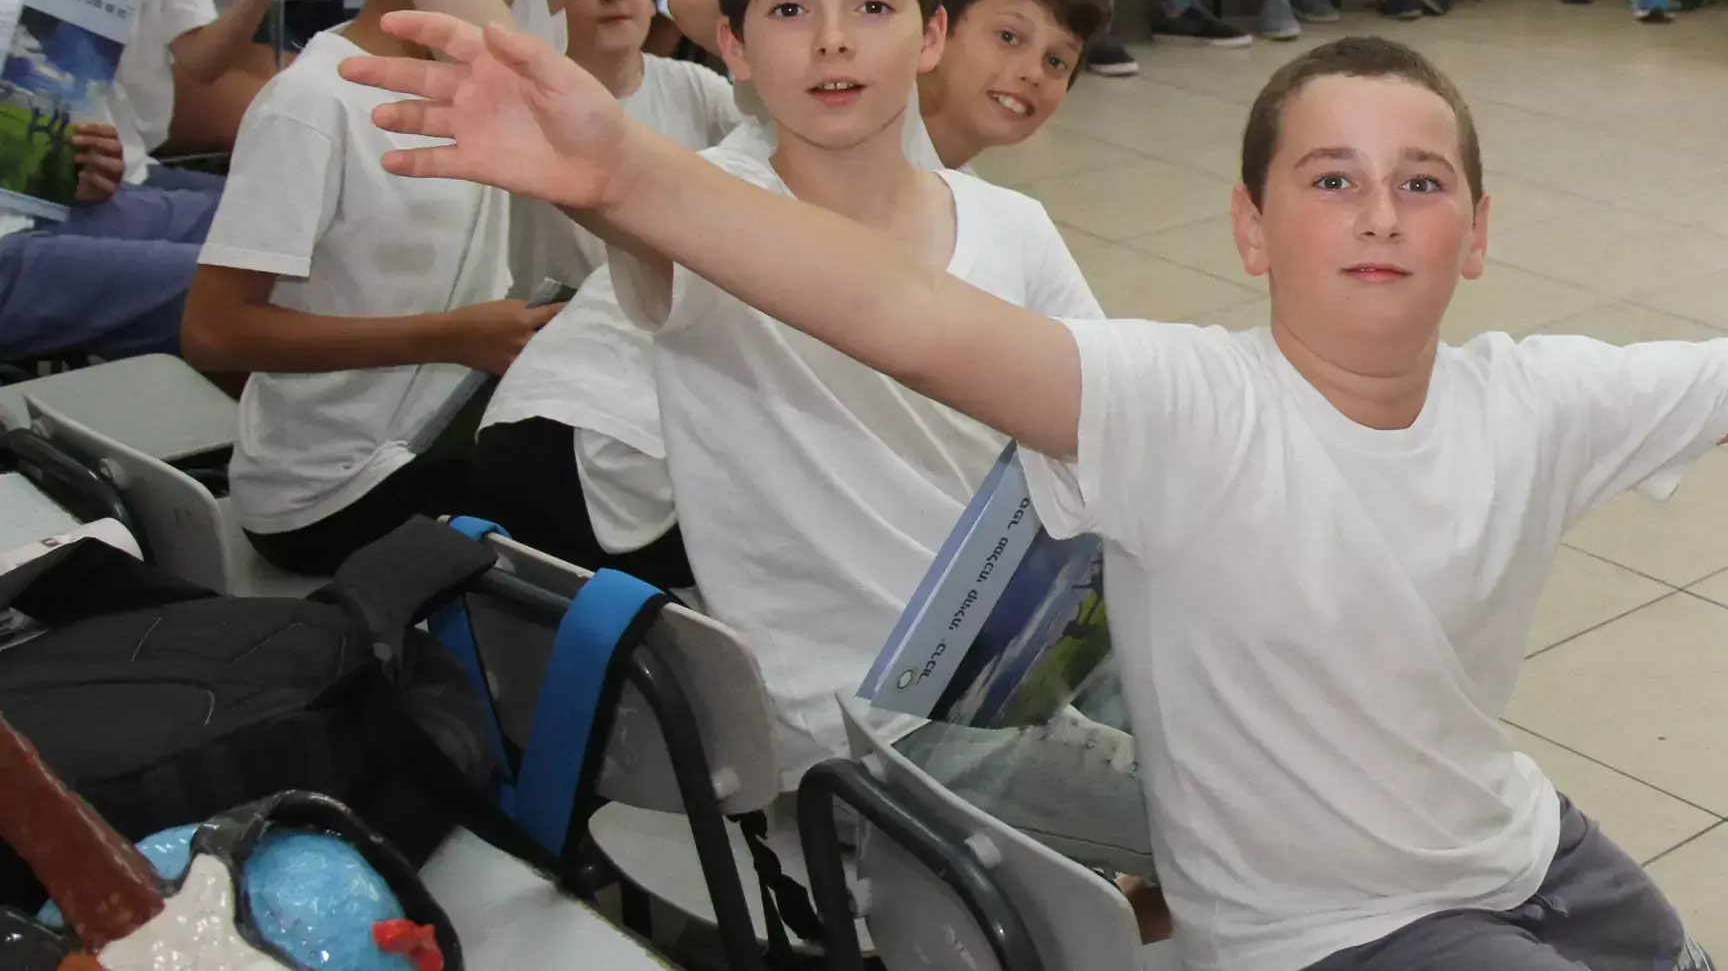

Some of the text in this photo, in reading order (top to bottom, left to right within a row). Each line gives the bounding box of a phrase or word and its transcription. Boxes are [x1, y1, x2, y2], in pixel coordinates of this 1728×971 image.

[1007, 496, 1030, 530] ספר
[976, 536, 1009, 583] ממלכתי
[948, 588, 978, 631] קהילתי
